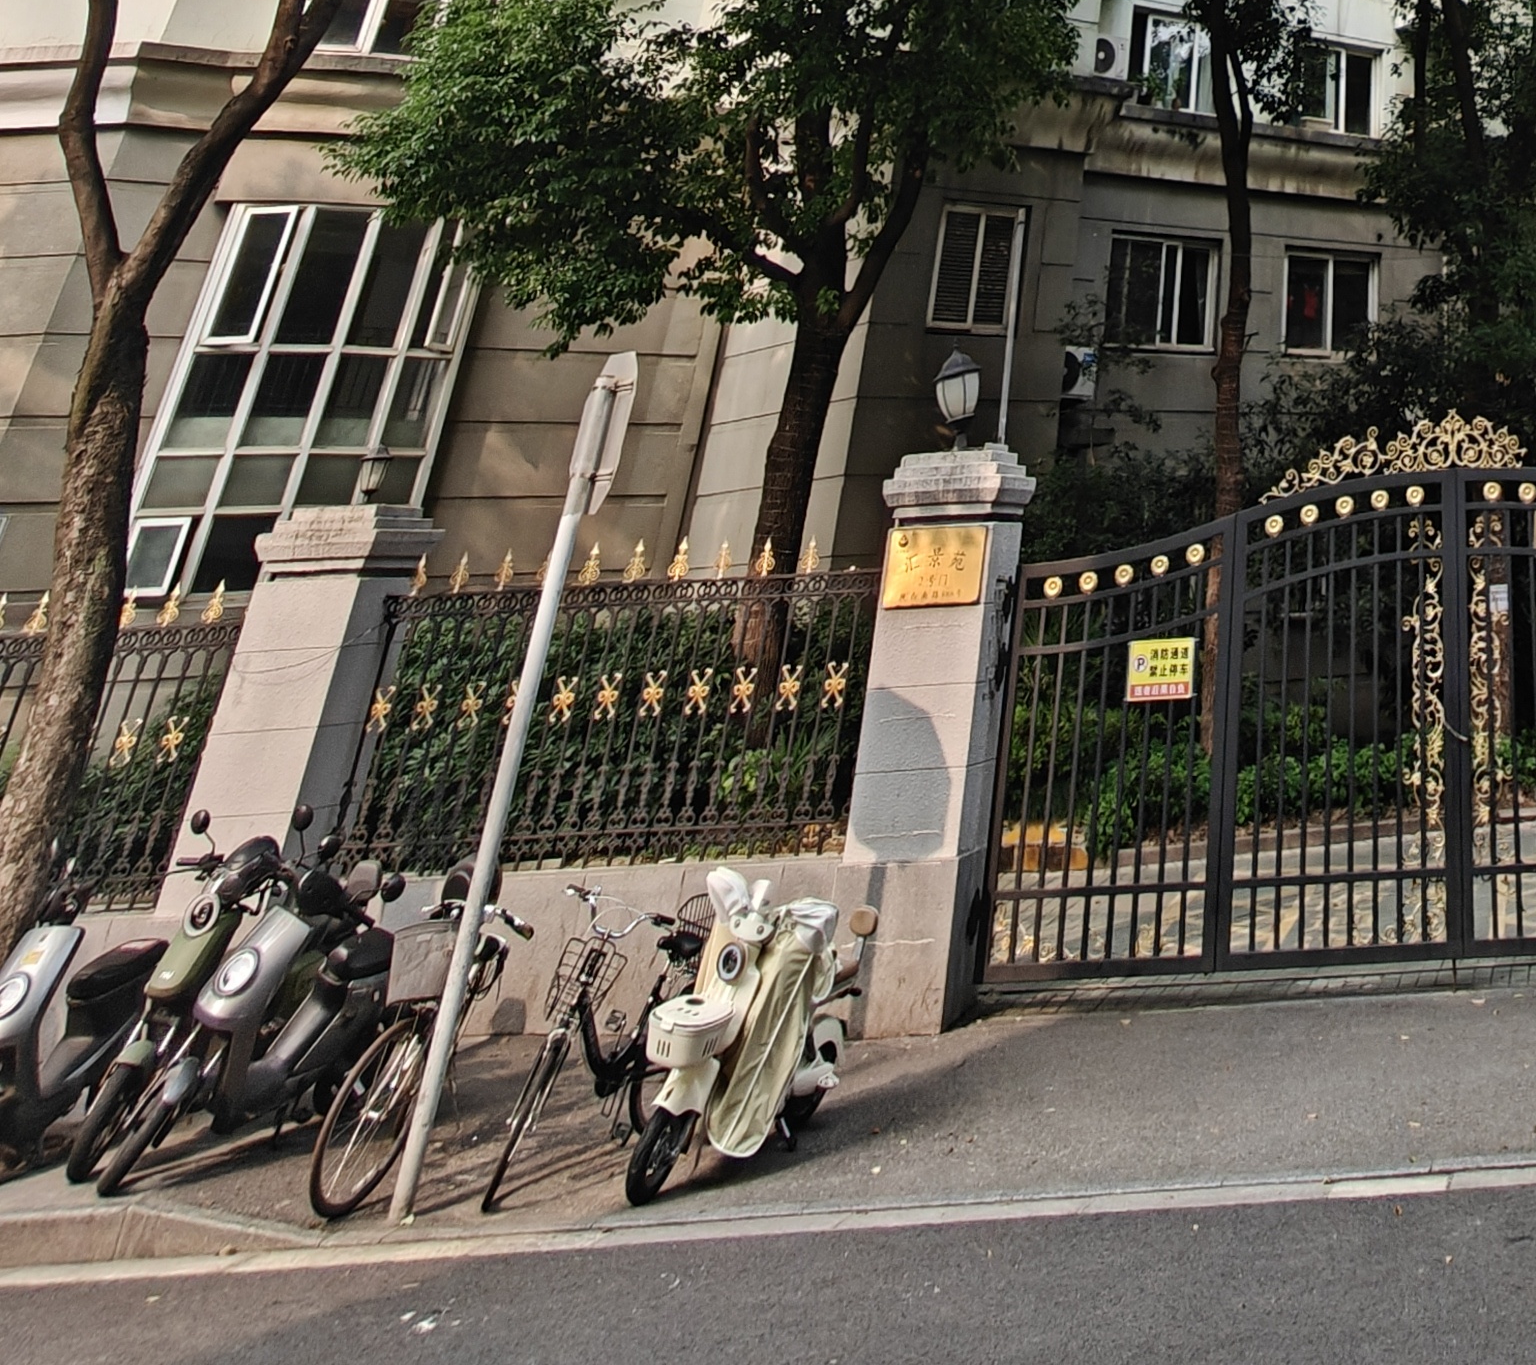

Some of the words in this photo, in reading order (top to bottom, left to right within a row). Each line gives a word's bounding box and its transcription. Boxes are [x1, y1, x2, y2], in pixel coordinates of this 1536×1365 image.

[905, 547, 967, 573] 汇景苑
[1149, 646, 1189, 661] 消防通道
[1149, 663, 1189, 677] 禁止停车
